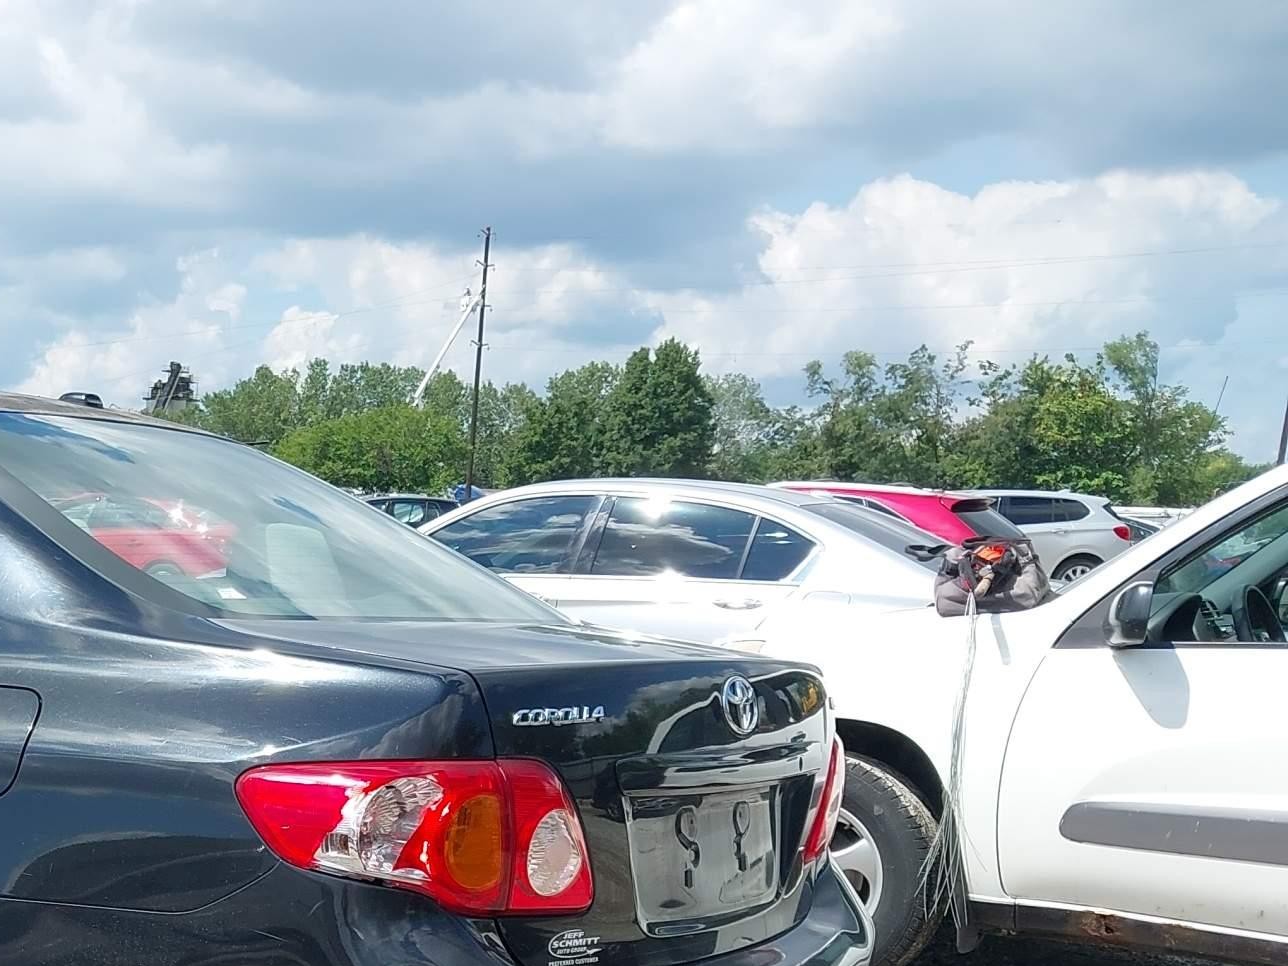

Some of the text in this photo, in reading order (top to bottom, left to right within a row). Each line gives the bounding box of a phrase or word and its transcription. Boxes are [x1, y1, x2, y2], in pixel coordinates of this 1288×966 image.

[512, 705, 605, 727] COROLLA
[563, 931, 585, 939] JEFF
[551, 936, 601, 948] SCHMITT
[575, 956, 599, 965] CUSTOMER
